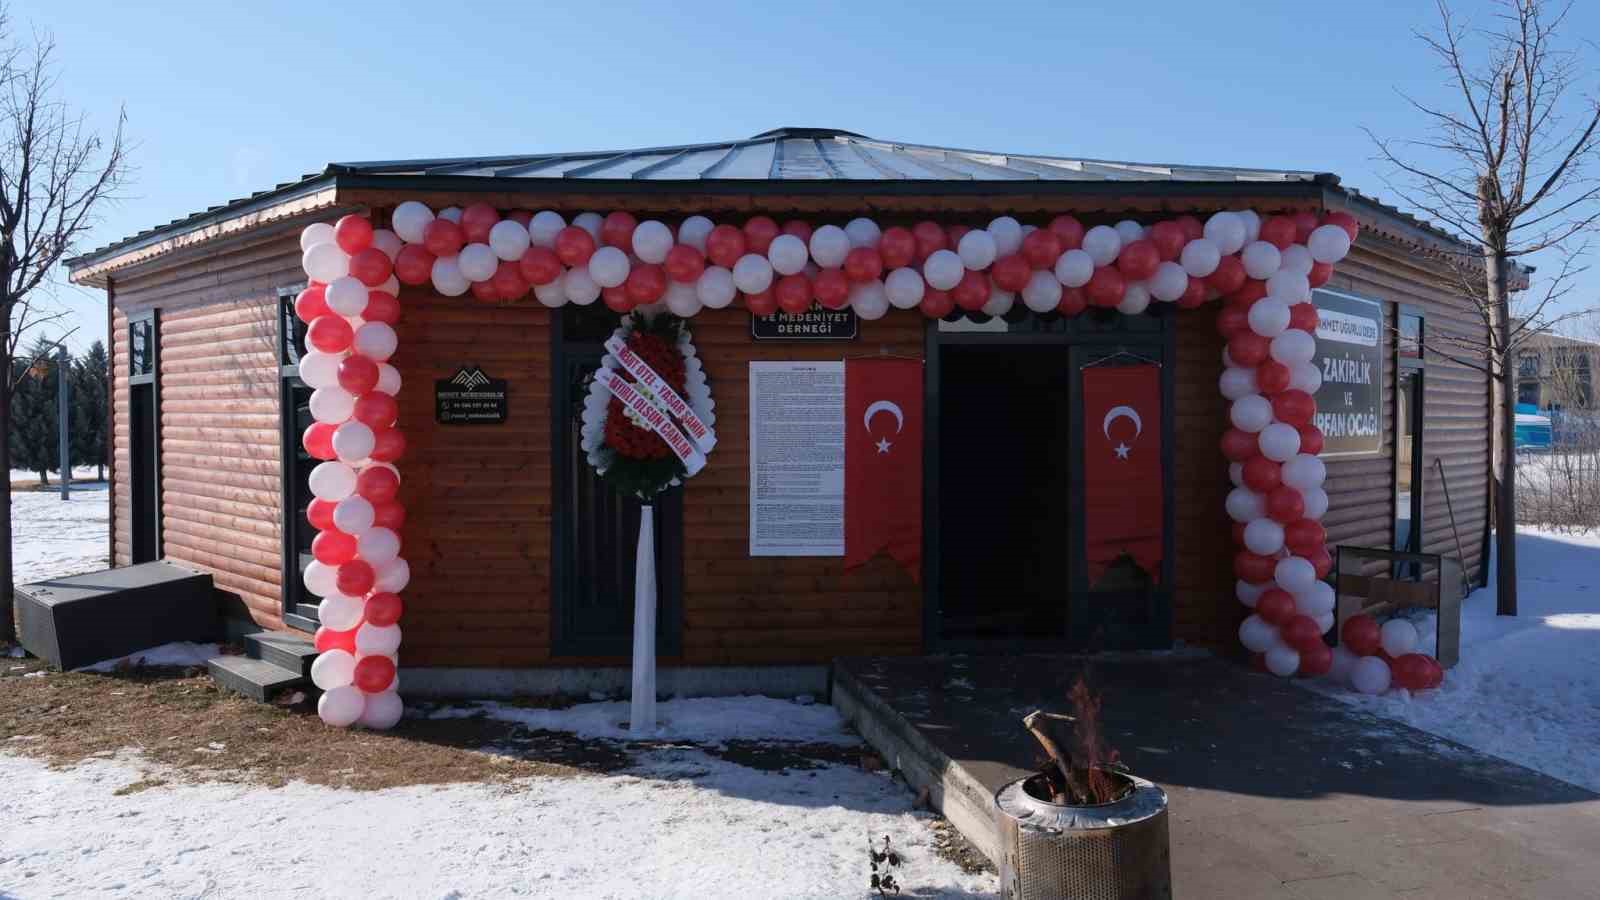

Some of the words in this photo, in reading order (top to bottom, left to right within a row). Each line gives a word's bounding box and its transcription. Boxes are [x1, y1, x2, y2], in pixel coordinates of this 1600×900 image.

[777, 322, 832, 334] DERNEĞİ
[779, 312, 849, 322] MEDENİYET
[1323, 352, 1371, 385] ZAKİRLİK
[1344, 391, 1353, 406] VE
[632, 397, 665, 427] OLSUN
[659, 422, 693, 460] CANLAR
[1347, 407, 1378, 437] OCAĞI
